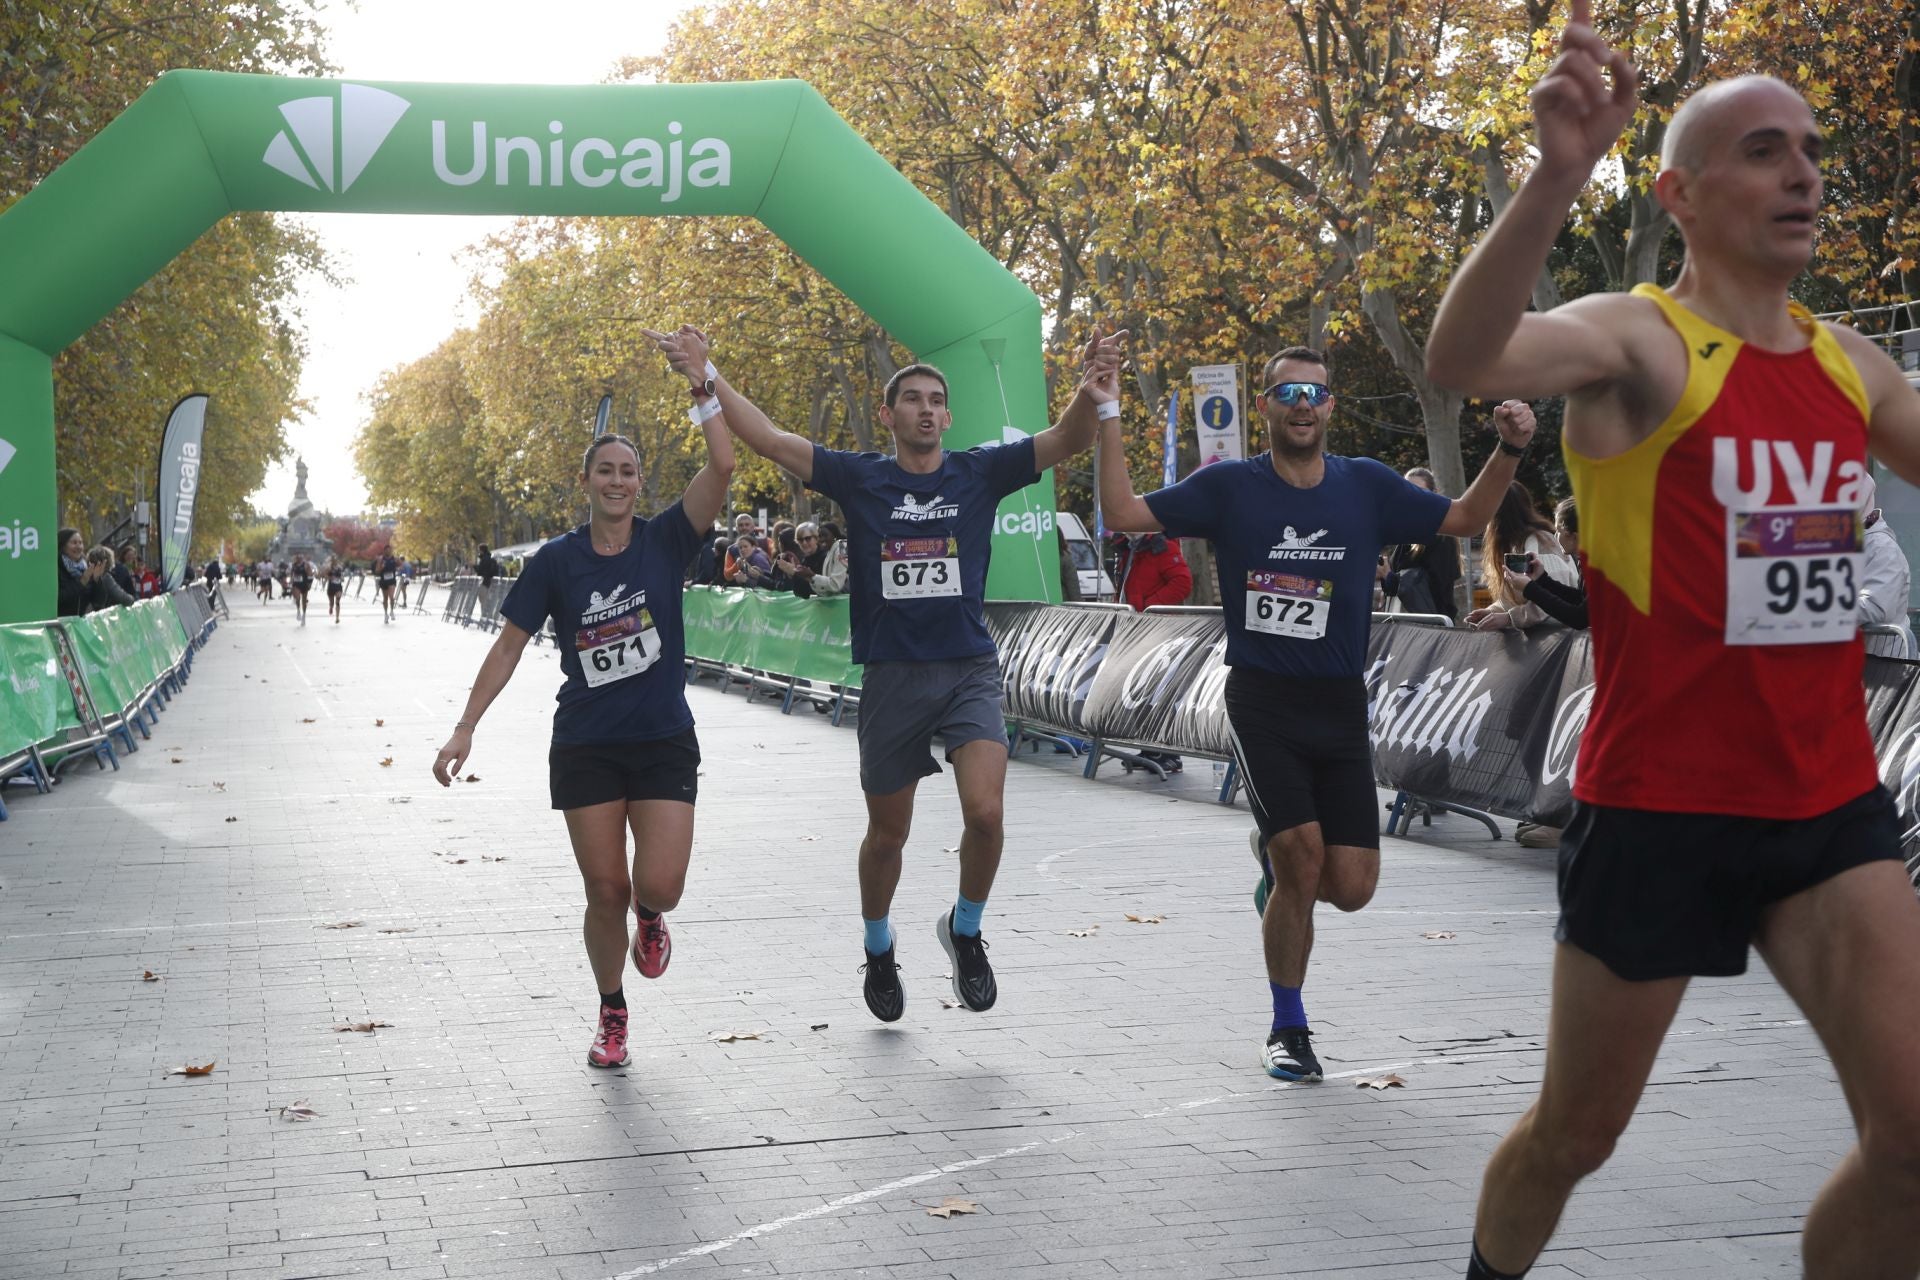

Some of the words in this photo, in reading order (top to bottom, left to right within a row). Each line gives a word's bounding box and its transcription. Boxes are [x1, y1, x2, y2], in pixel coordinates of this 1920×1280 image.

[432, 120, 731, 203] Unicaja
[173, 442, 200, 534] Unicaja
[1712, 437, 1867, 507] UVa
[891, 508, 959, 522] MICHELIN
[993, 504, 1053, 541] icaja
[0, 519, 39, 559] aja
[1268, 550, 1345, 561] MICHELIN
[892, 561, 949, 586] 673
[1766, 557, 1856, 614] 953
[581, 594, 646, 626] MICHELIN
[1257, 595, 1315, 626] 672
[592, 636, 648, 672] 671
